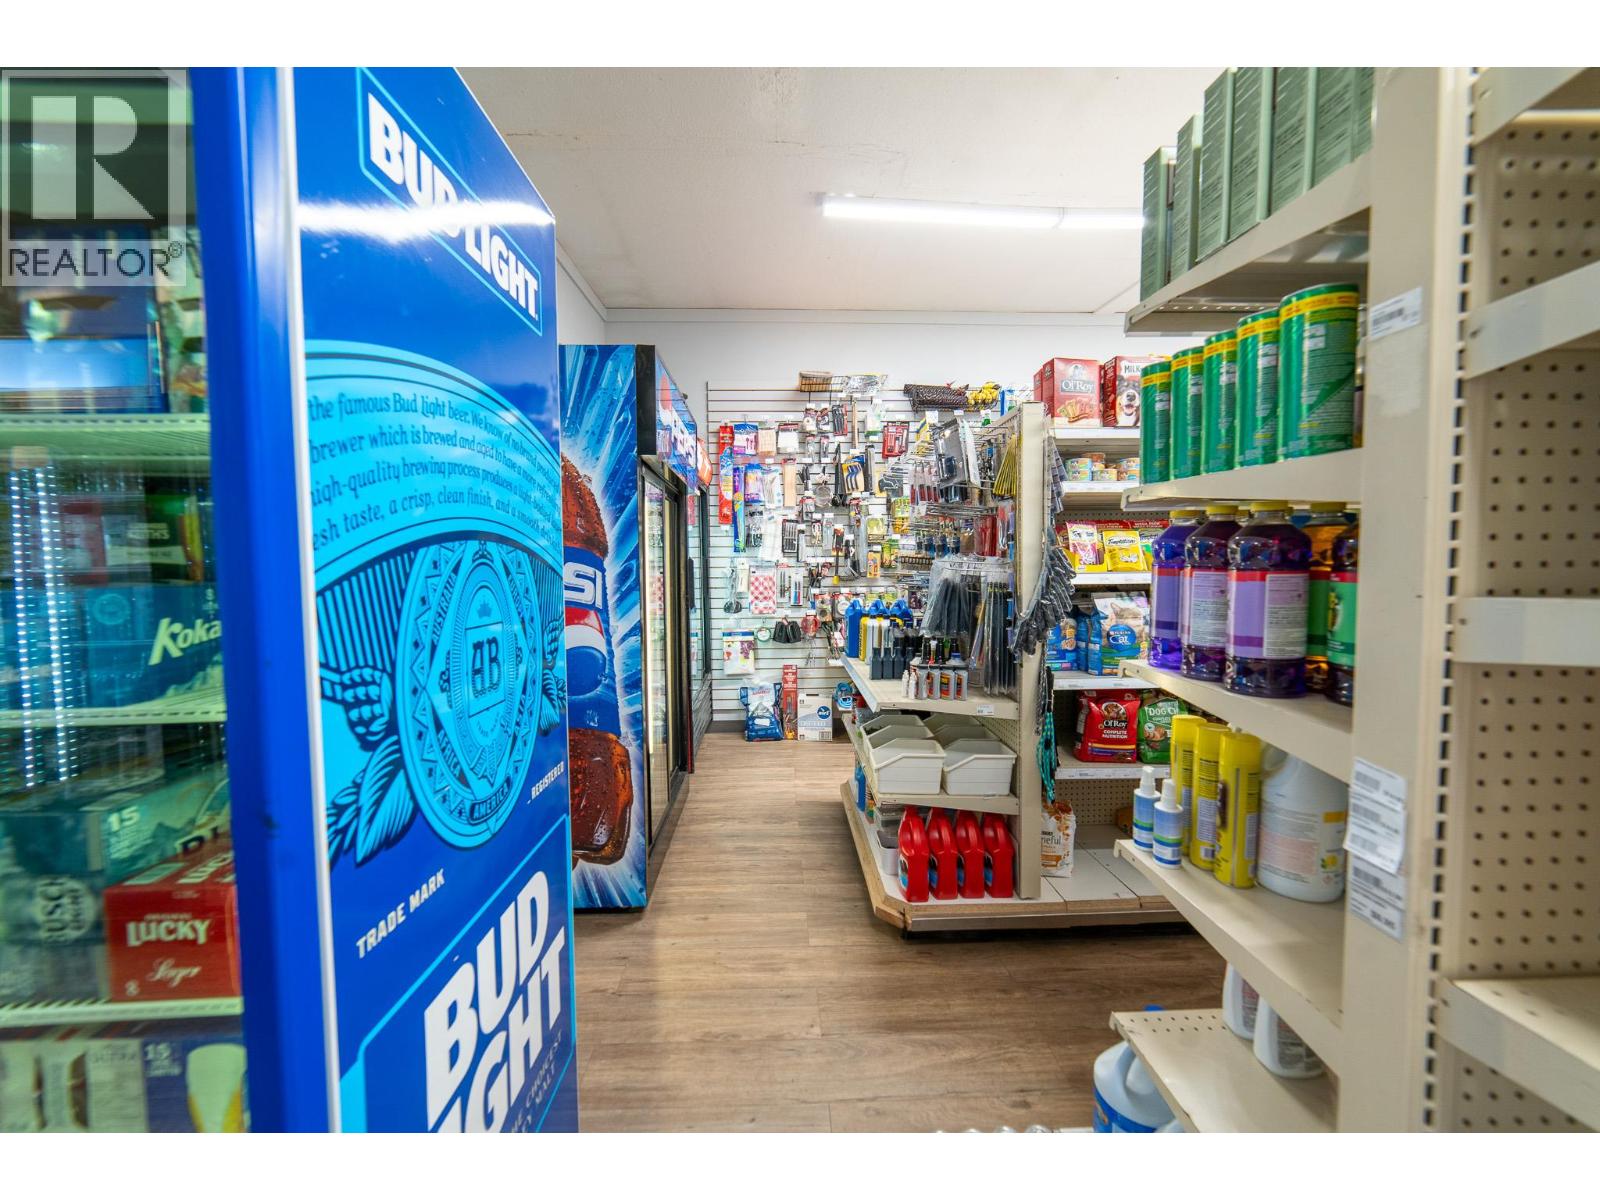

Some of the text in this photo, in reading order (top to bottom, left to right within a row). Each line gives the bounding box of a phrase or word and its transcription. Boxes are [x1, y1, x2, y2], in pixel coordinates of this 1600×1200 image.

[368, 92, 539, 321] BUD LIGHT
[308, 394, 333, 421] the
[338, 392, 391, 422] famous
[392, 392, 418, 413] Bud
[309, 438, 365, 464] brewer
[368, 424, 409, 449] which
[410, 424, 421, 445] is
[422, 424, 457, 447] brewed
[459, 434, 476, 452] and
[402, 456, 446, 479] brewing
[447, 462, 480, 478] process
[312, 518, 340, 552] esh
[389, 499, 398, 516] a
[438, 485, 465, 505] clean
[149, 617, 222, 666] Koka
[126, 918, 212, 948] LUCKY
[356, 868, 445, 959] TRADE MARK
[424, 871, 549, 1132] BUD
